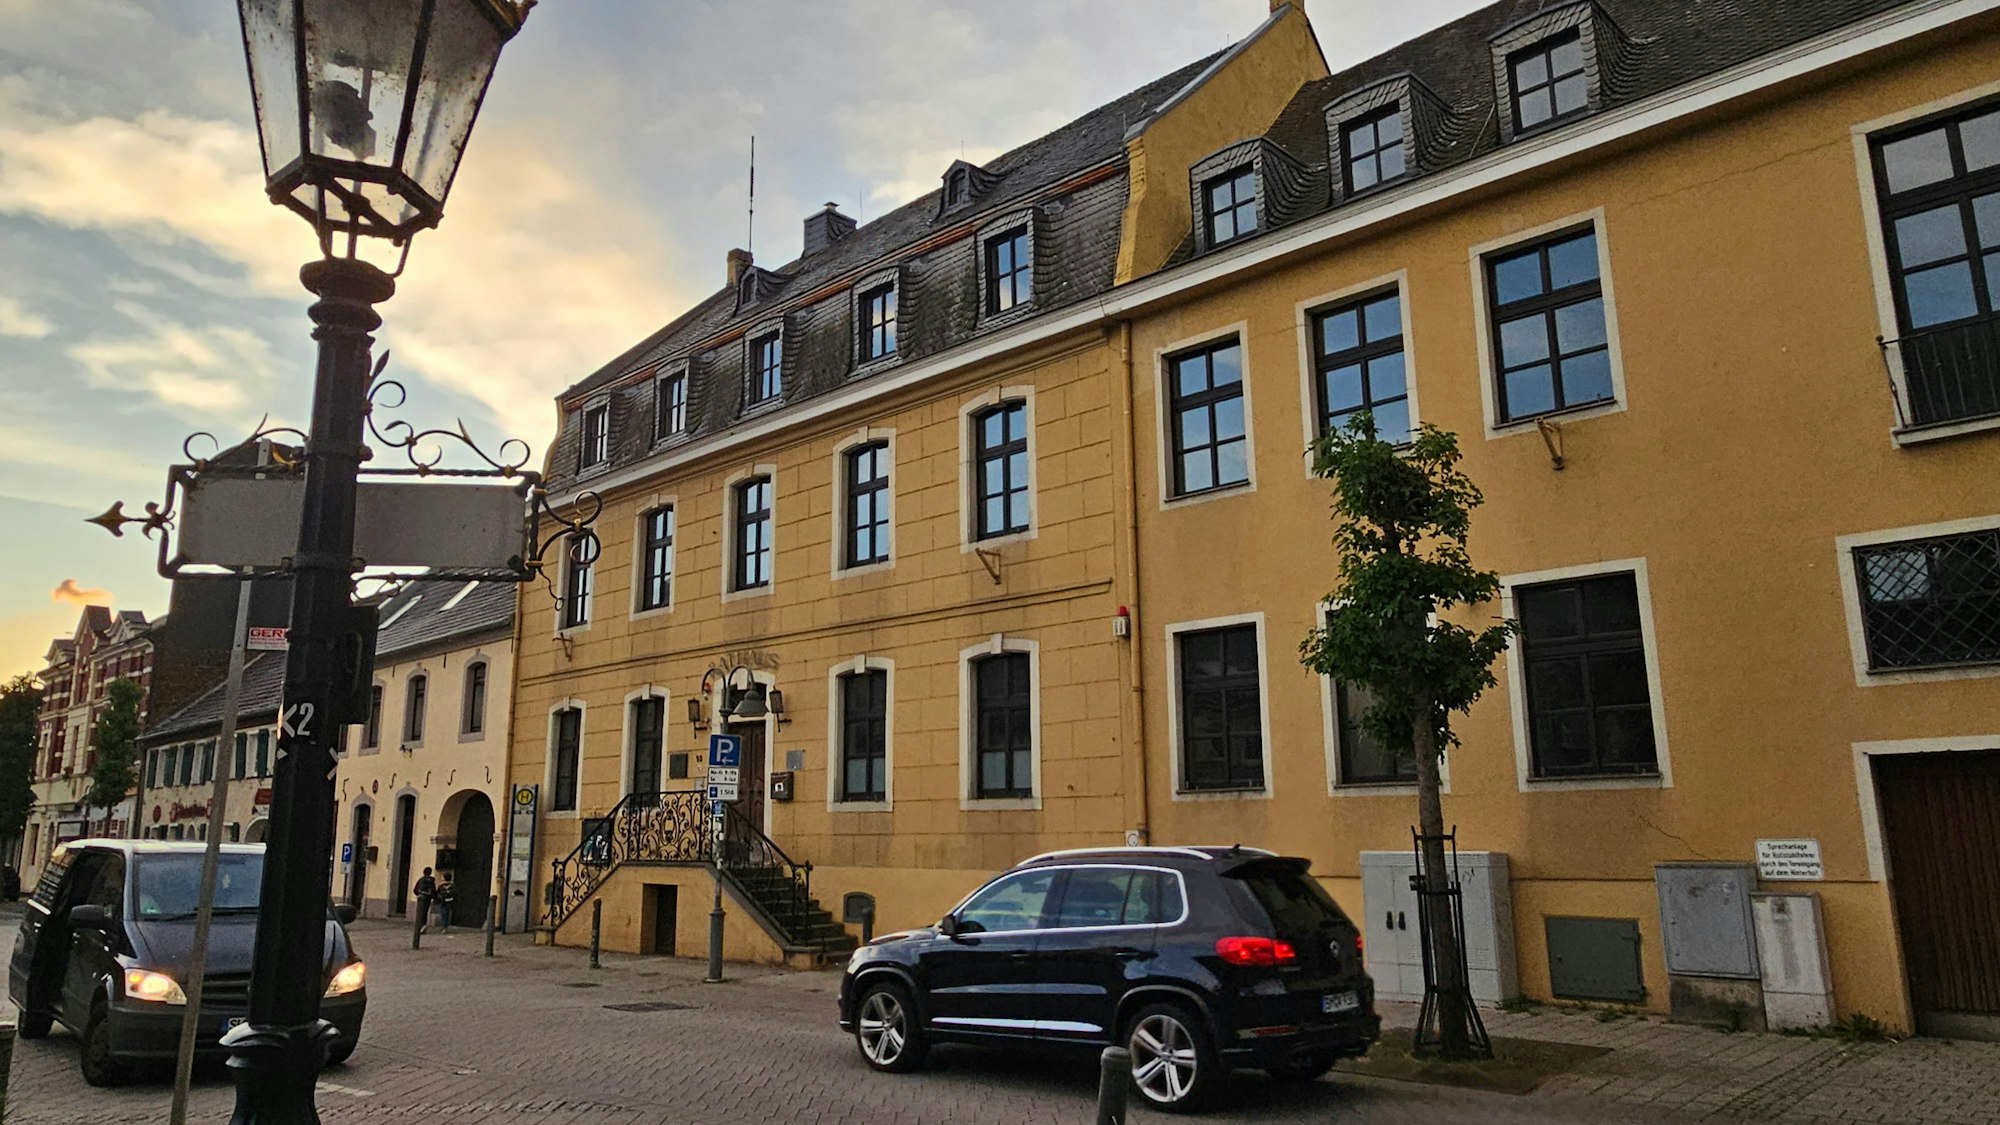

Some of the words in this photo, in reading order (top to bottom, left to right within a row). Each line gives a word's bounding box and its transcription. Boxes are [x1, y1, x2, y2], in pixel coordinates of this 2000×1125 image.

[250, 628, 288, 638] GER
[716, 738, 734, 762] P
[520, 791, 530, 803] H
[343, 845, 351, 861] P
